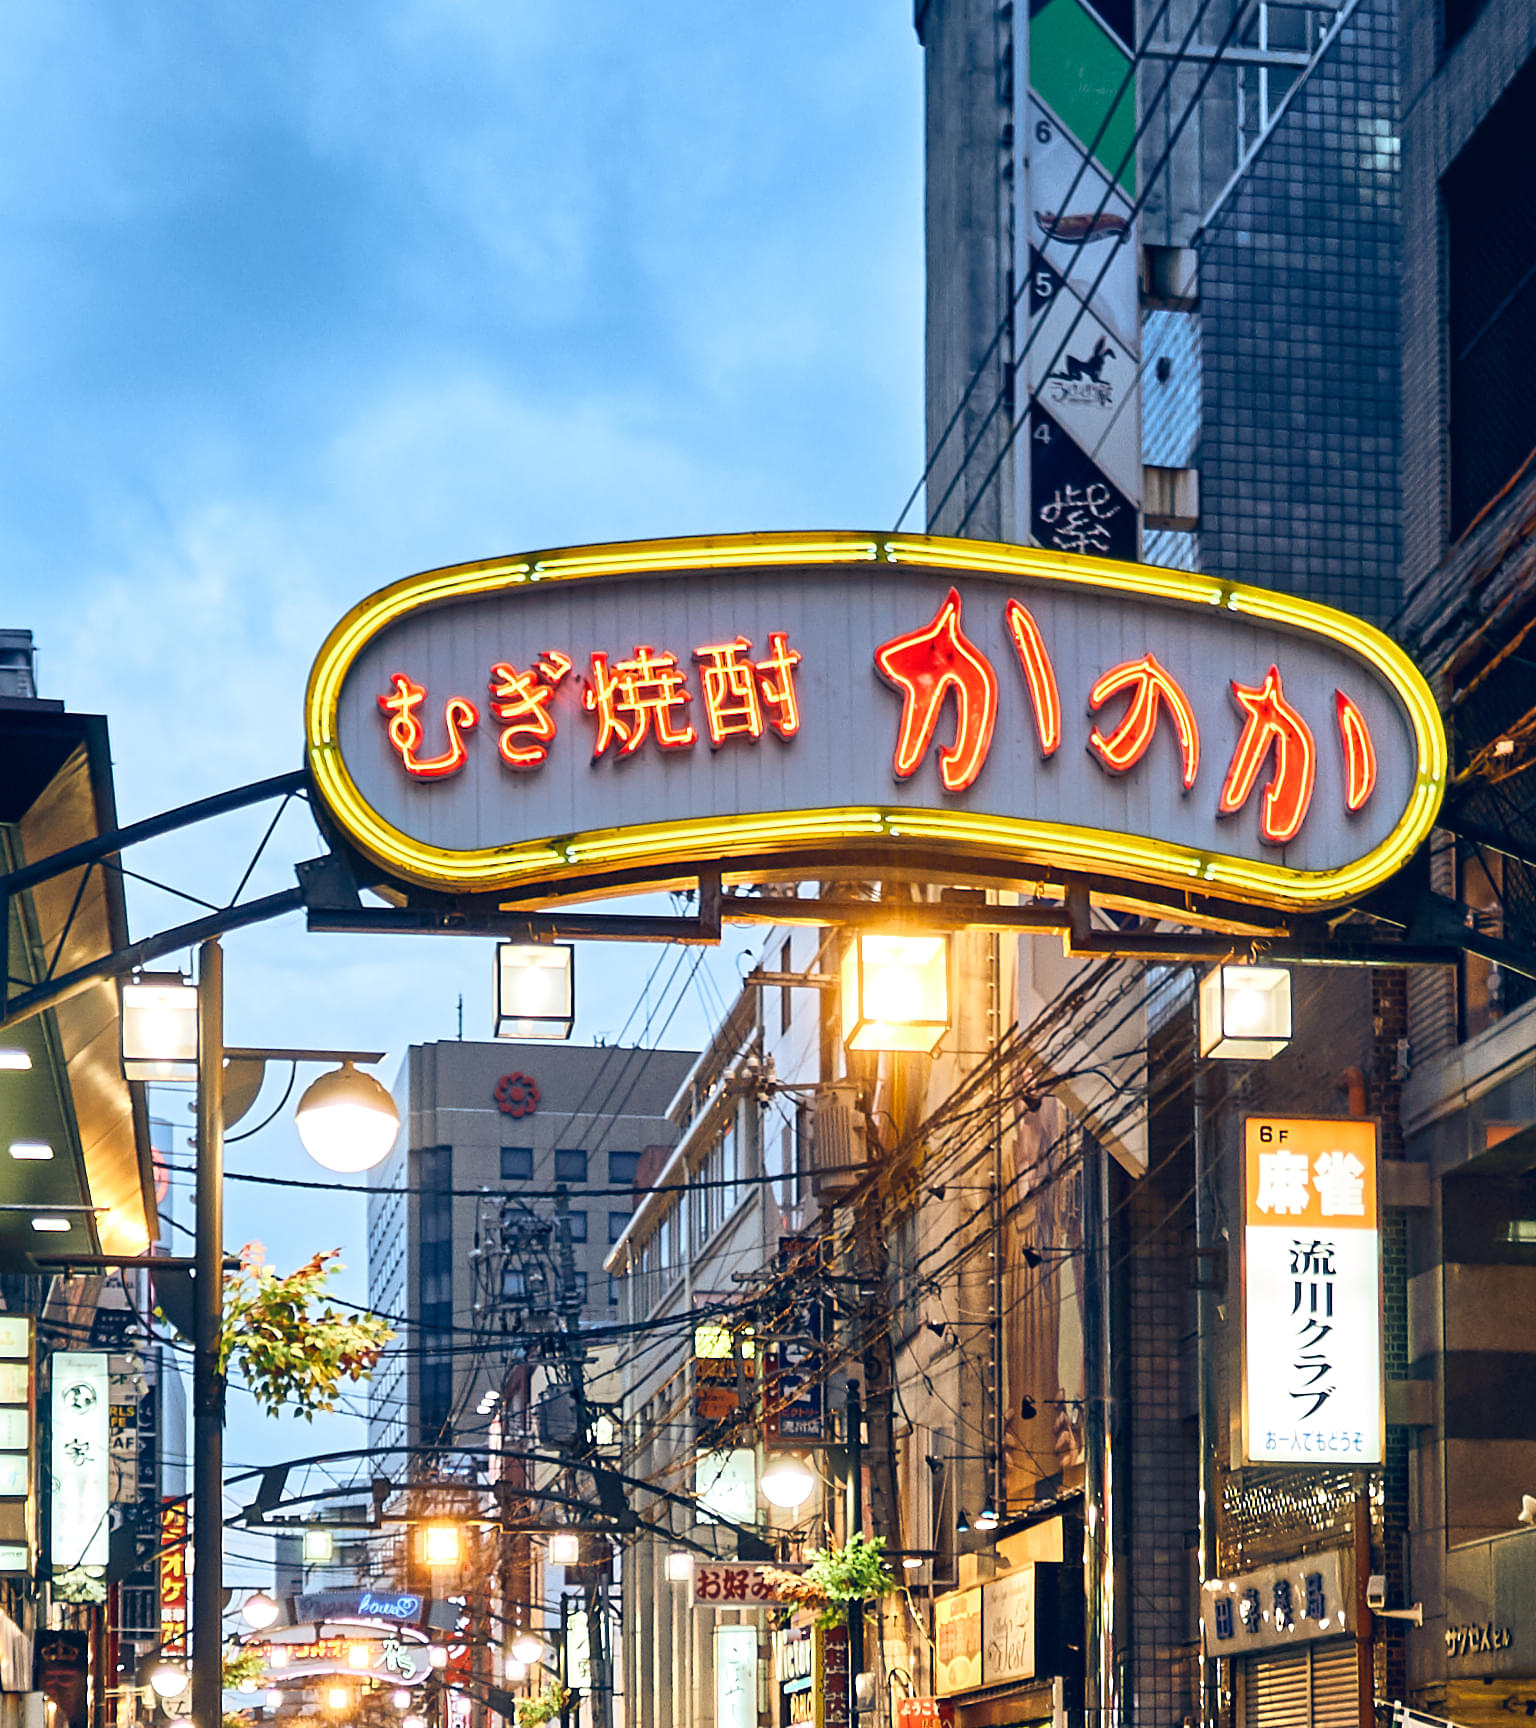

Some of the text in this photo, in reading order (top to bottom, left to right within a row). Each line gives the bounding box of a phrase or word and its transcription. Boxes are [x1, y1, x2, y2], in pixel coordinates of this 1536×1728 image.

[1036, 121, 1052, 144] 6
[1036, 273, 1052, 297] 5
[1034, 424, 1051, 446] 4
[376, 585, 1379, 847] むぎ焼酎 かのか
[1256, 1150, 1365, 1216] 麻雀
[1288, 1239, 1337, 1422] 流川クラブ
[110, 1406, 135, 1417] RLS
[1265, 1431, 1363, 1453] お一人でもどうぞ
